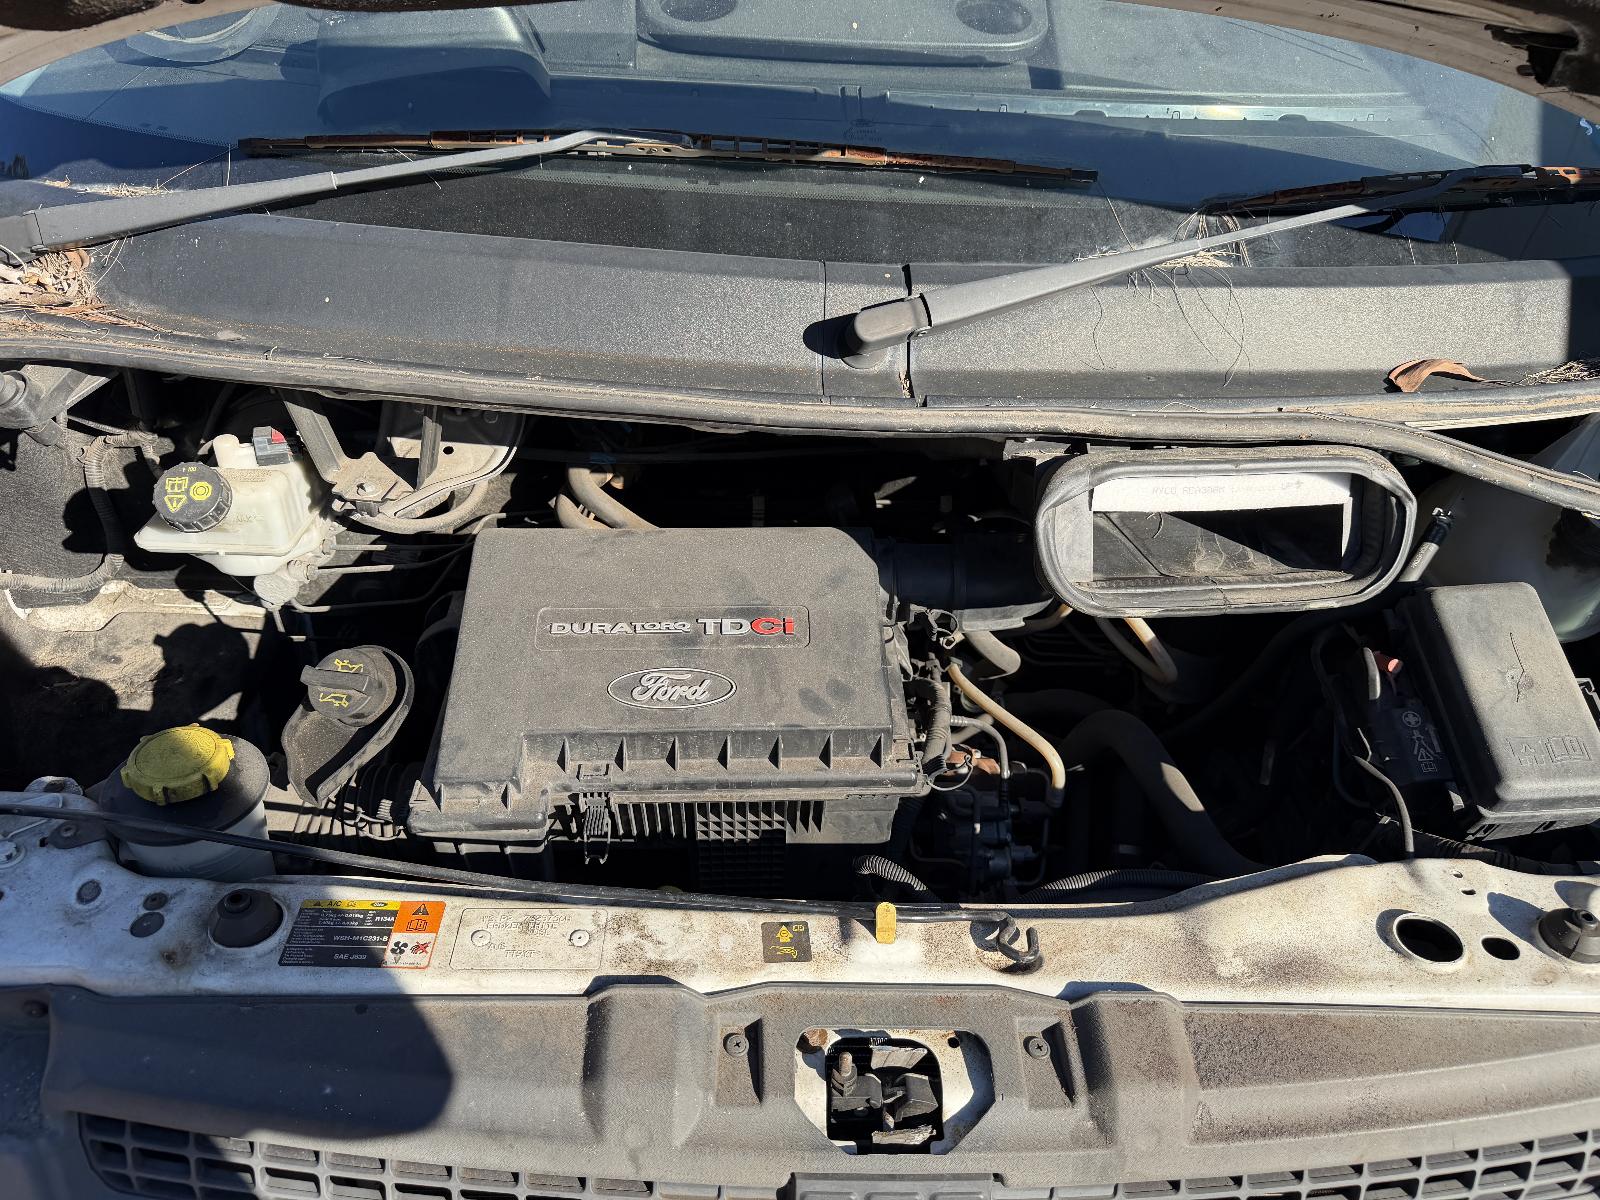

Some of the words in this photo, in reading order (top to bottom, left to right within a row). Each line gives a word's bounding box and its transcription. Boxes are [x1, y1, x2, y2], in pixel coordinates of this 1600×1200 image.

[549, 621, 691, 635] DURATORQ
[697, 617, 795, 636] TDCi
[630, 672, 712, 702] Ford
